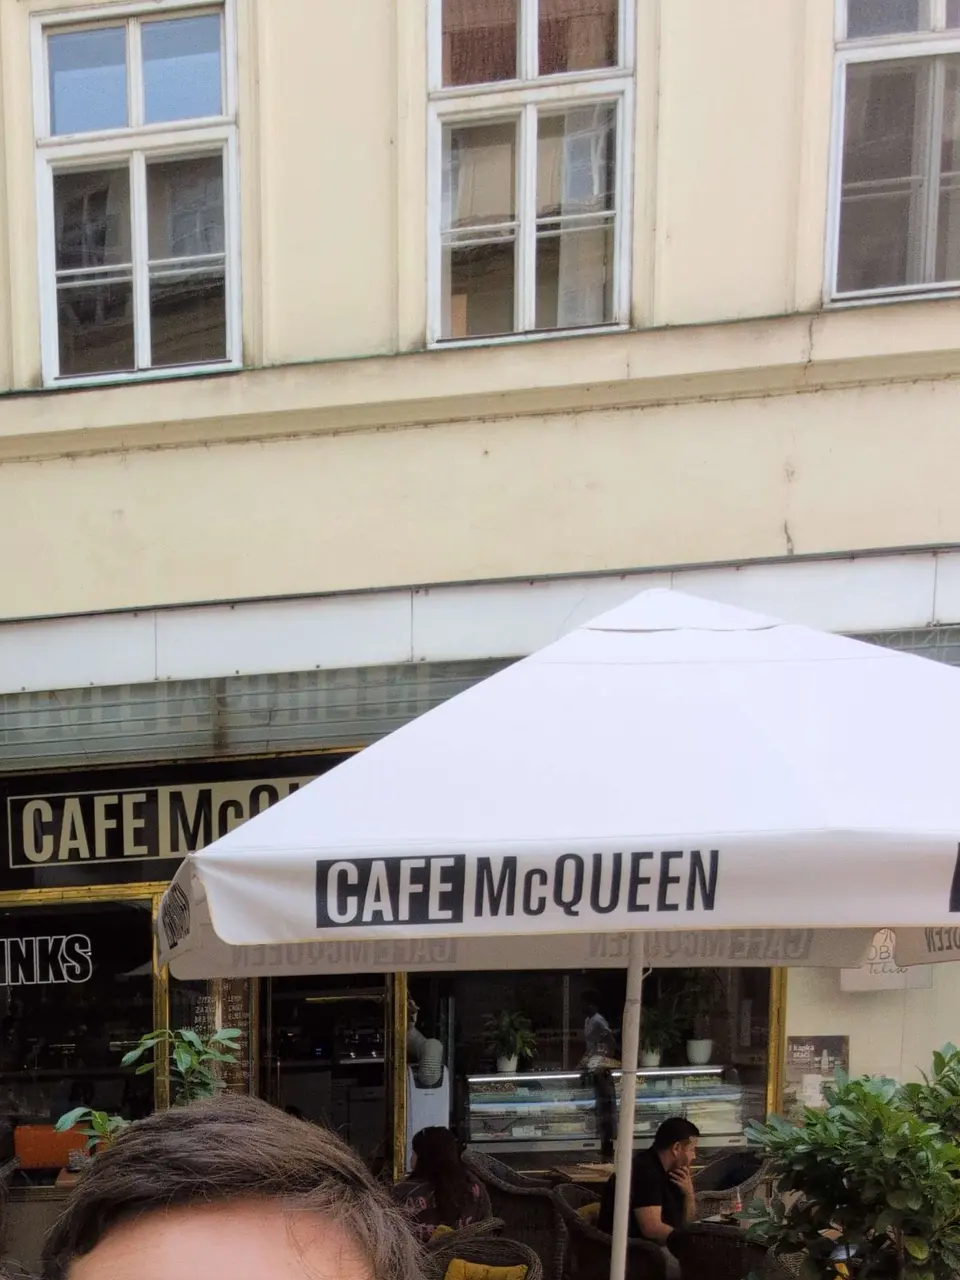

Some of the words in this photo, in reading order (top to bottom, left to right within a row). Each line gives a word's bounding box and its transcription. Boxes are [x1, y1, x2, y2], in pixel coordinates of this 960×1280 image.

[22, 791, 149, 863] CAFE
[326, 857, 453, 924] CAFE
[474, 849, 720, 917] McQUEEN
